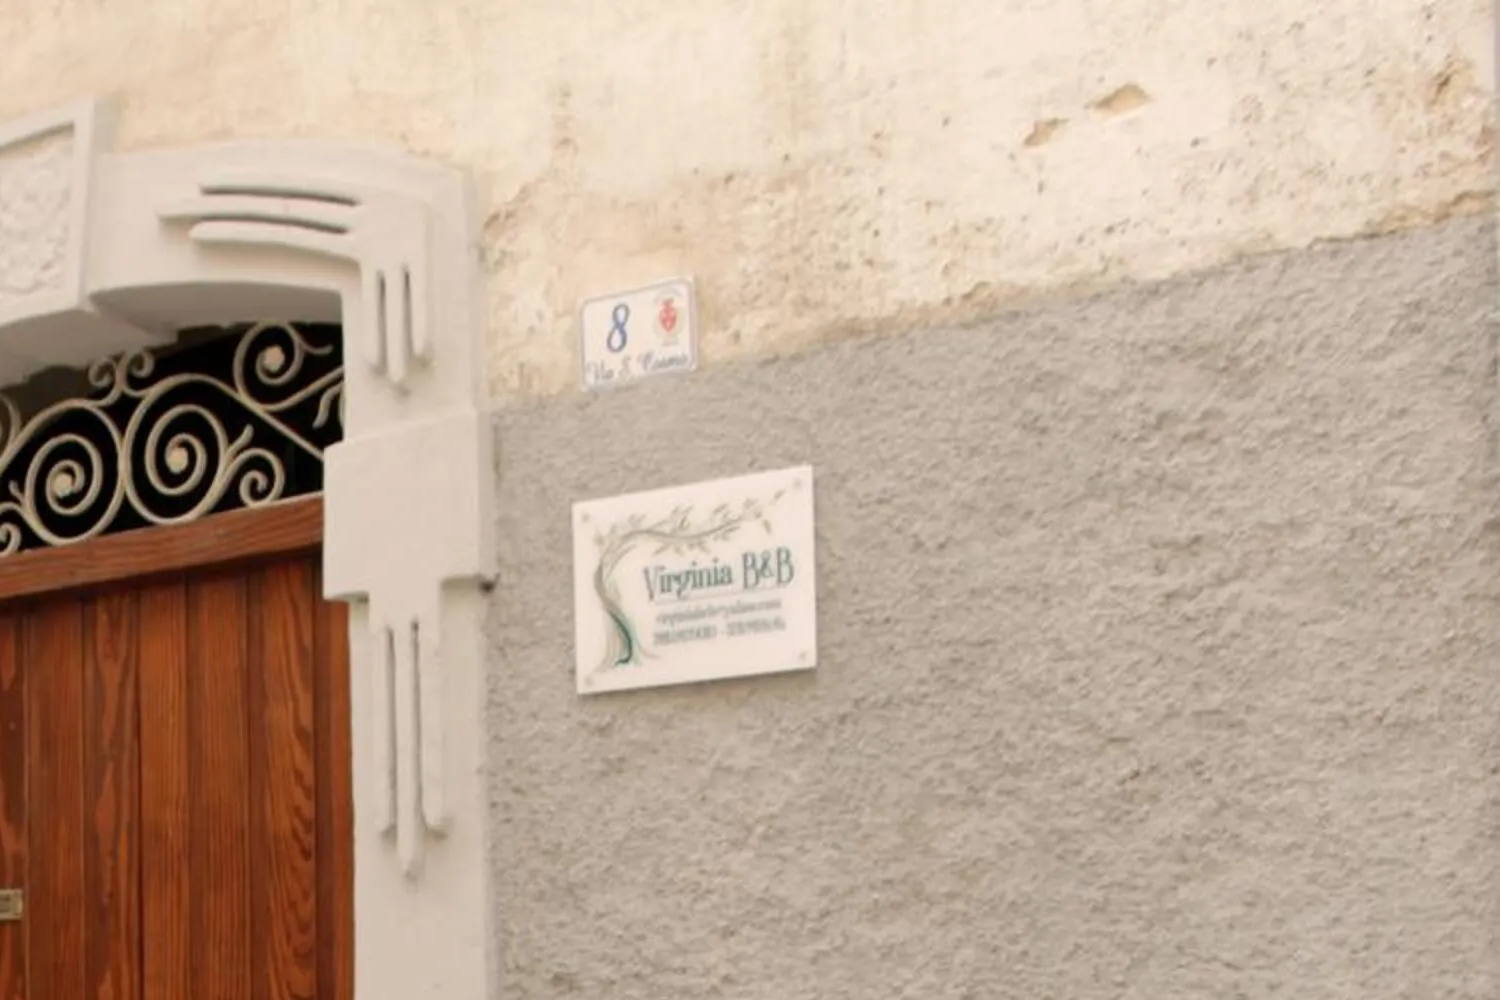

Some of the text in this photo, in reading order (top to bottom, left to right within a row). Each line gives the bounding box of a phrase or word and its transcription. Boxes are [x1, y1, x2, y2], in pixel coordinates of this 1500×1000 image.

[606, 303, 630, 353] 8
[643, 546, 795, 602] Virginia B&B
